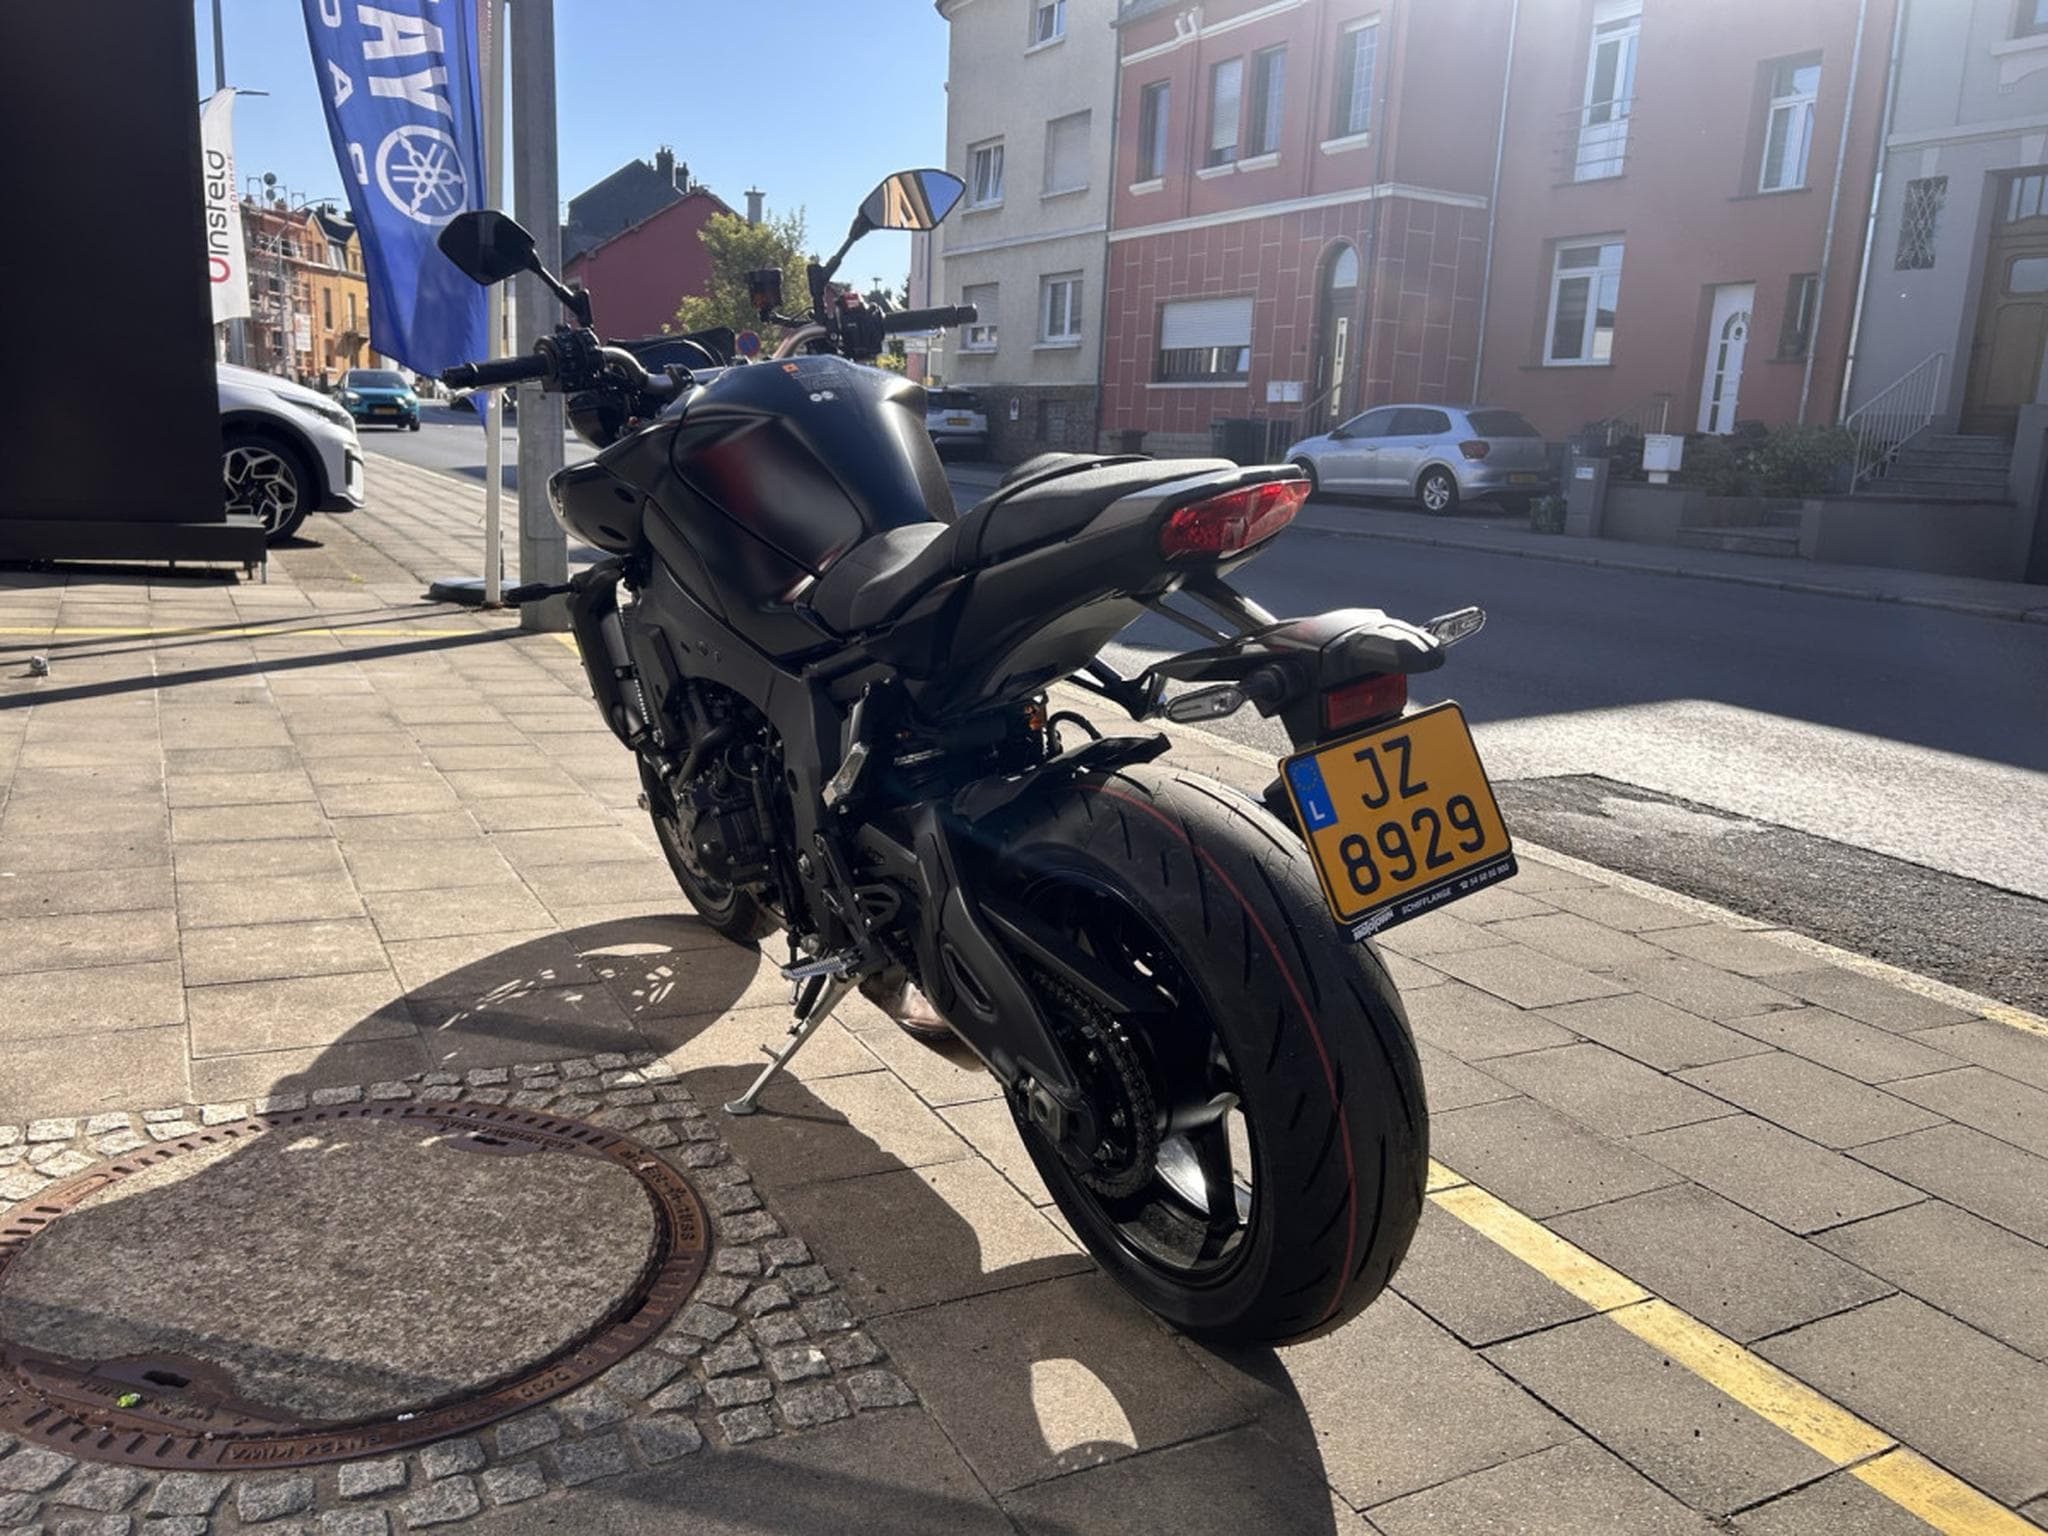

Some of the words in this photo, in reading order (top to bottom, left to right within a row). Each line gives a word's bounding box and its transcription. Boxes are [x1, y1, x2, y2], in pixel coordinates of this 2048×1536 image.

[1354, 735, 1429, 809] JZ
[1308, 801, 1326, 821] L
[1339, 794, 1486, 896] 8929
